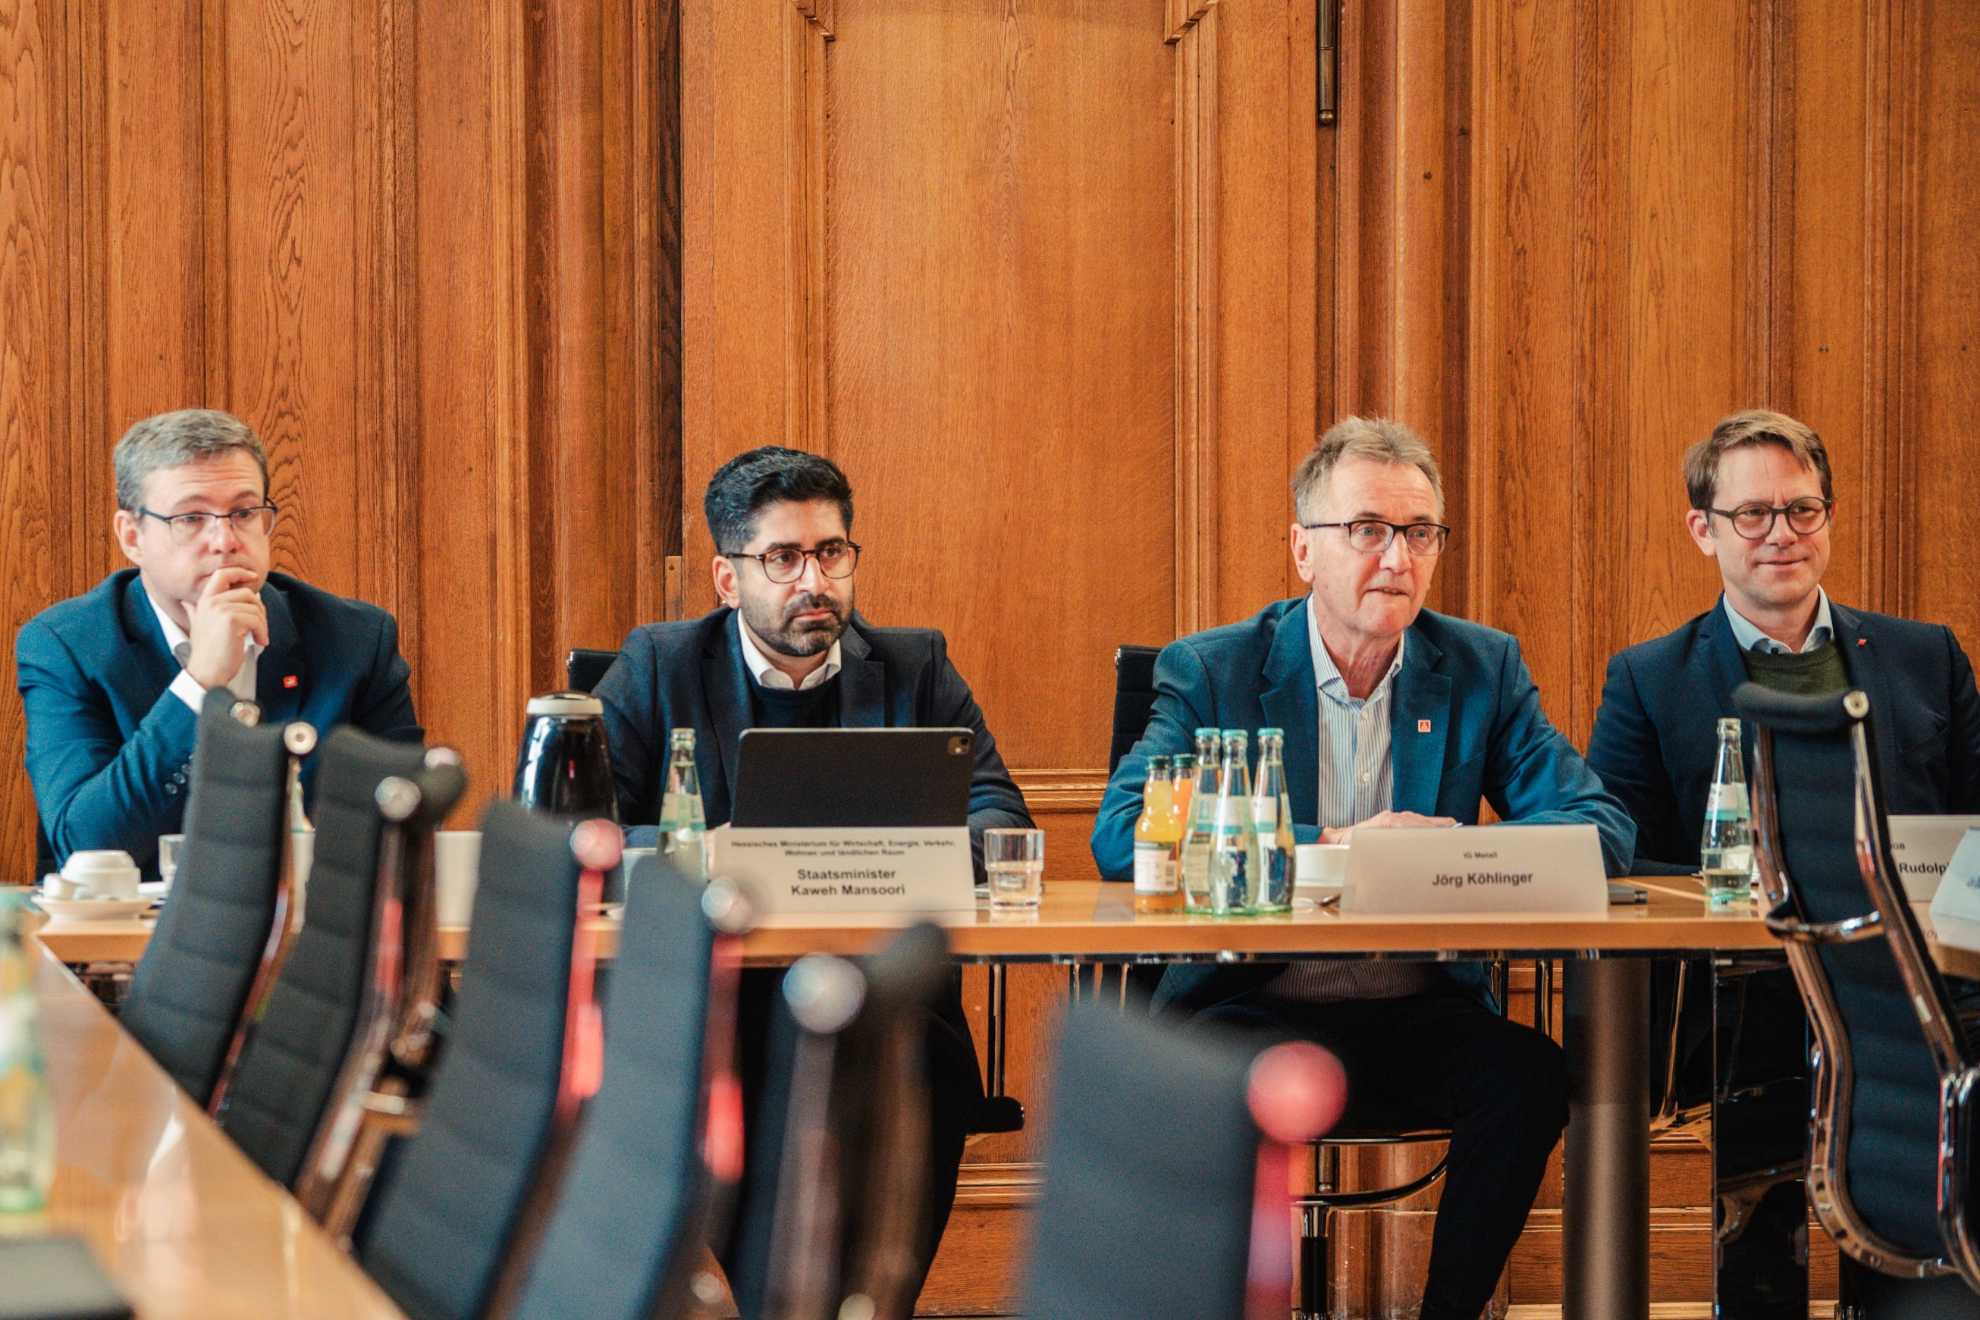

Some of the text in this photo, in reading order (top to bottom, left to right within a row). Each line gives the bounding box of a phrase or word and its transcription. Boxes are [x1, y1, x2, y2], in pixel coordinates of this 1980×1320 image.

[829, 839, 840, 847] für
[797, 868, 896, 881] Staatsminister
[1899, 861, 1949, 876] Rudolp
[1432, 871, 1533, 888] Jörg Köhlinger
[791, 883, 905, 896] Kaweh Mansoori
